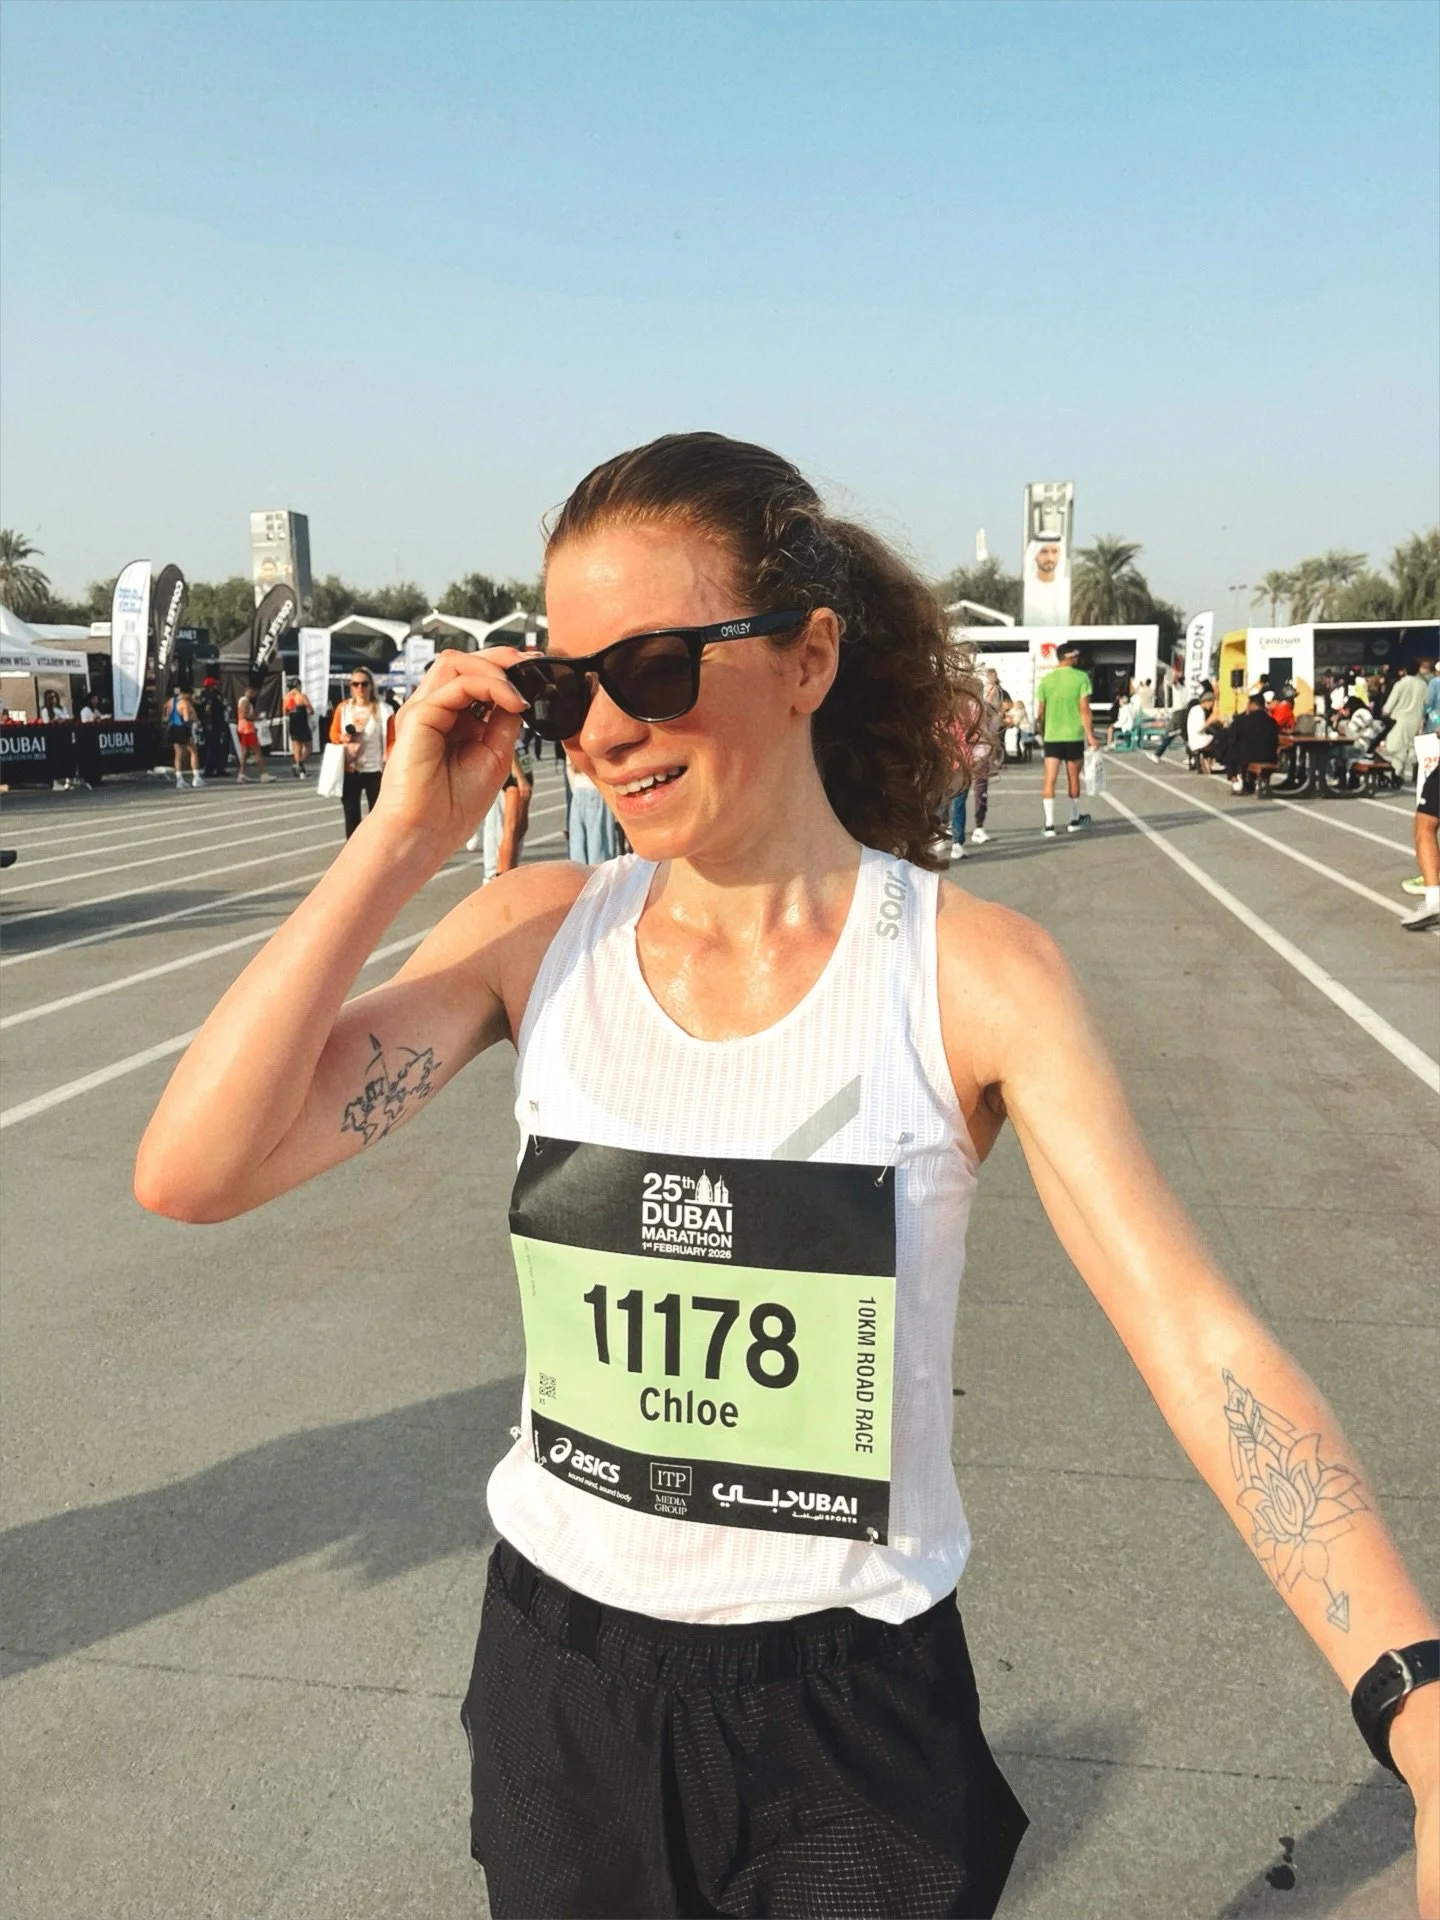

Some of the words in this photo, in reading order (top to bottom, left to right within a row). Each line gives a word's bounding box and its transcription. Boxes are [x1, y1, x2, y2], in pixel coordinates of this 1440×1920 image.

[176, 630, 197, 640] LANET
[721, 622, 751, 637] OAKLEY
[1191, 624, 1205, 698] HALEON
[0, 736, 46, 755] DUBAI
[99, 732, 134, 749] DUBAI
[642, 1172, 695, 1202] 25th
[642, 1200, 733, 1233] DUBAI
[641, 1225, 733, 1249] MARATHON
[653, 1242, 707, 1257] FEBRUARY
[708, 1248, 732, 1260] 2026
[857, 1297, 877, 1346] 10KM
[584, 1284, 800, 1389] 11178
[856, 1352, 875, 1403] ROAD
[640, 1387, 739, 1428] Chloe
[855, 1408, 874, 1454] RACE
[568, 1472, 585, 1484] sound
[599, 1485, 617, 1497] sound
[616, 1490, 632, 1503] body
[657, 1470, 687, 1489] ITP
[654, 1503, 689, 1516] GROUP
[655, 1494, 687, 1507] MEDIA
[824, 1514, 858, 1524] SPORTS
